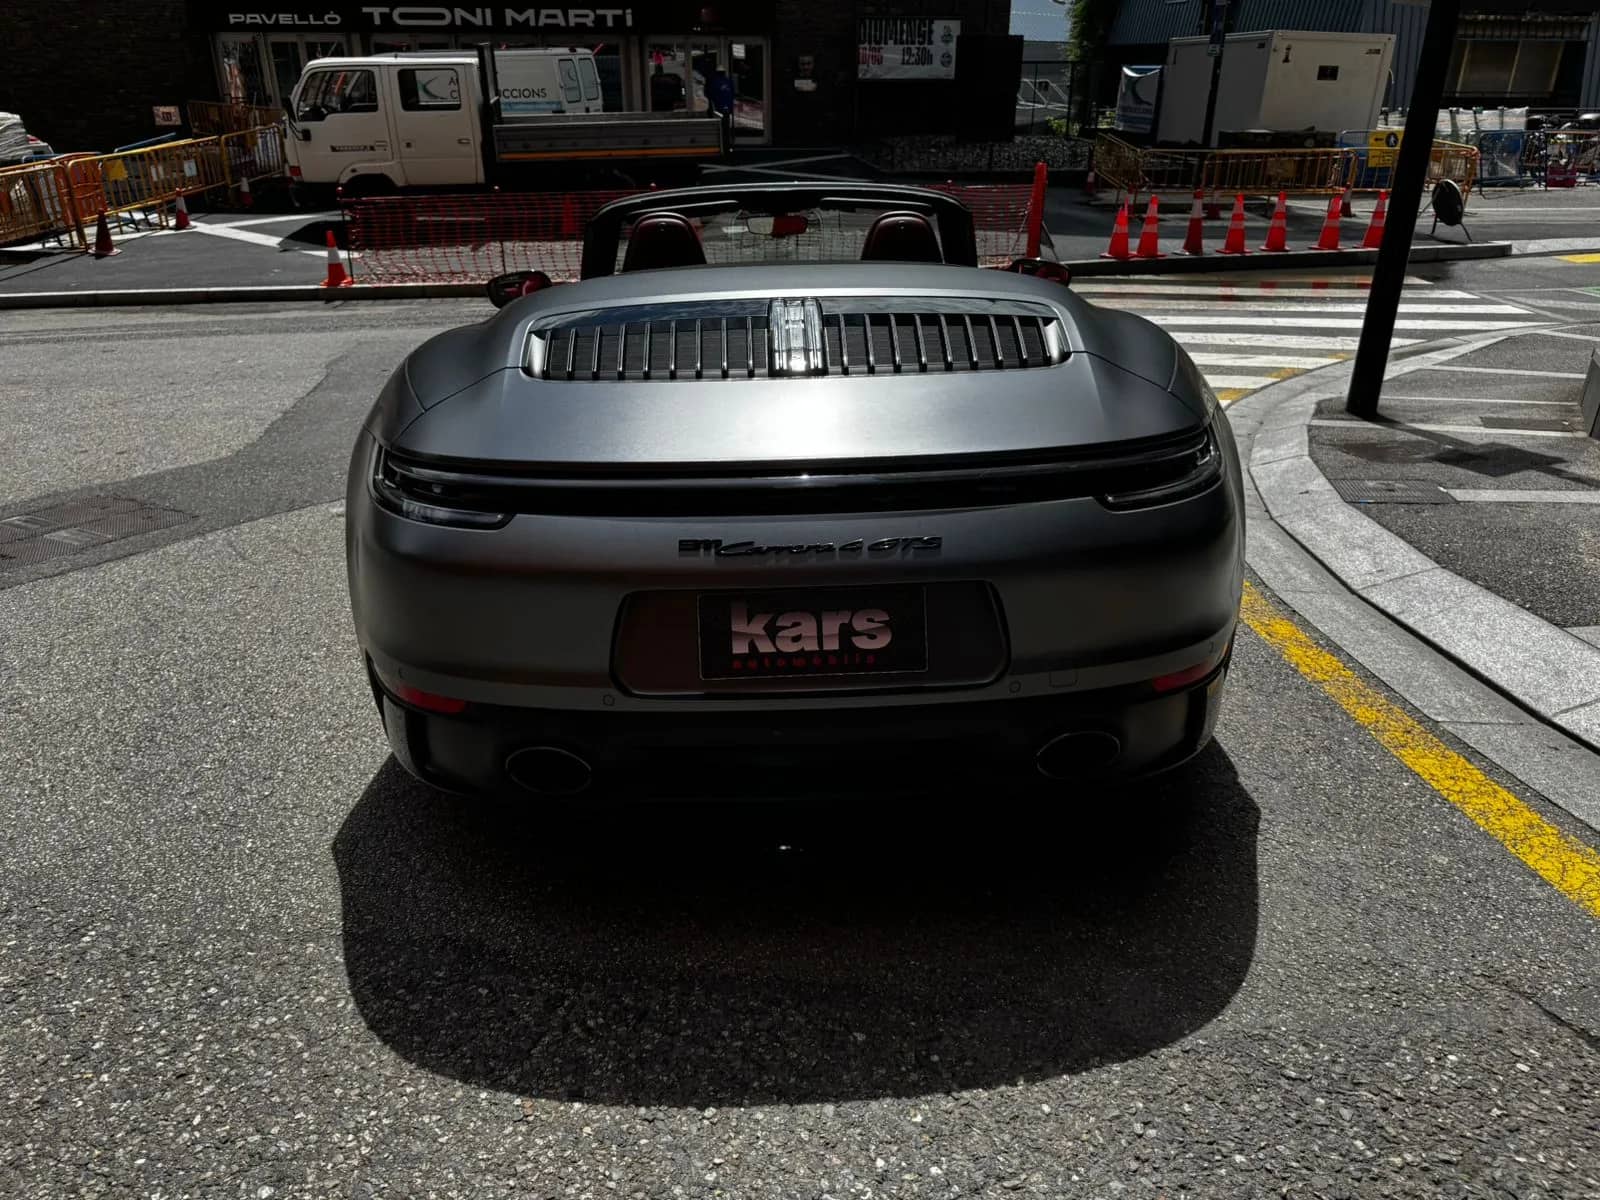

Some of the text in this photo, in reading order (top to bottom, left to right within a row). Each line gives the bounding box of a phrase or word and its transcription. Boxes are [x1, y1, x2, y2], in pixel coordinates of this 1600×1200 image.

[361, 7, 492, 26] TONI
[901, 47, 933, 66] 12:30h
[716, 540, 836, 557] Carrera
[867, 536, 942, 552] GTS
[731, 600, 893, 655] kars
